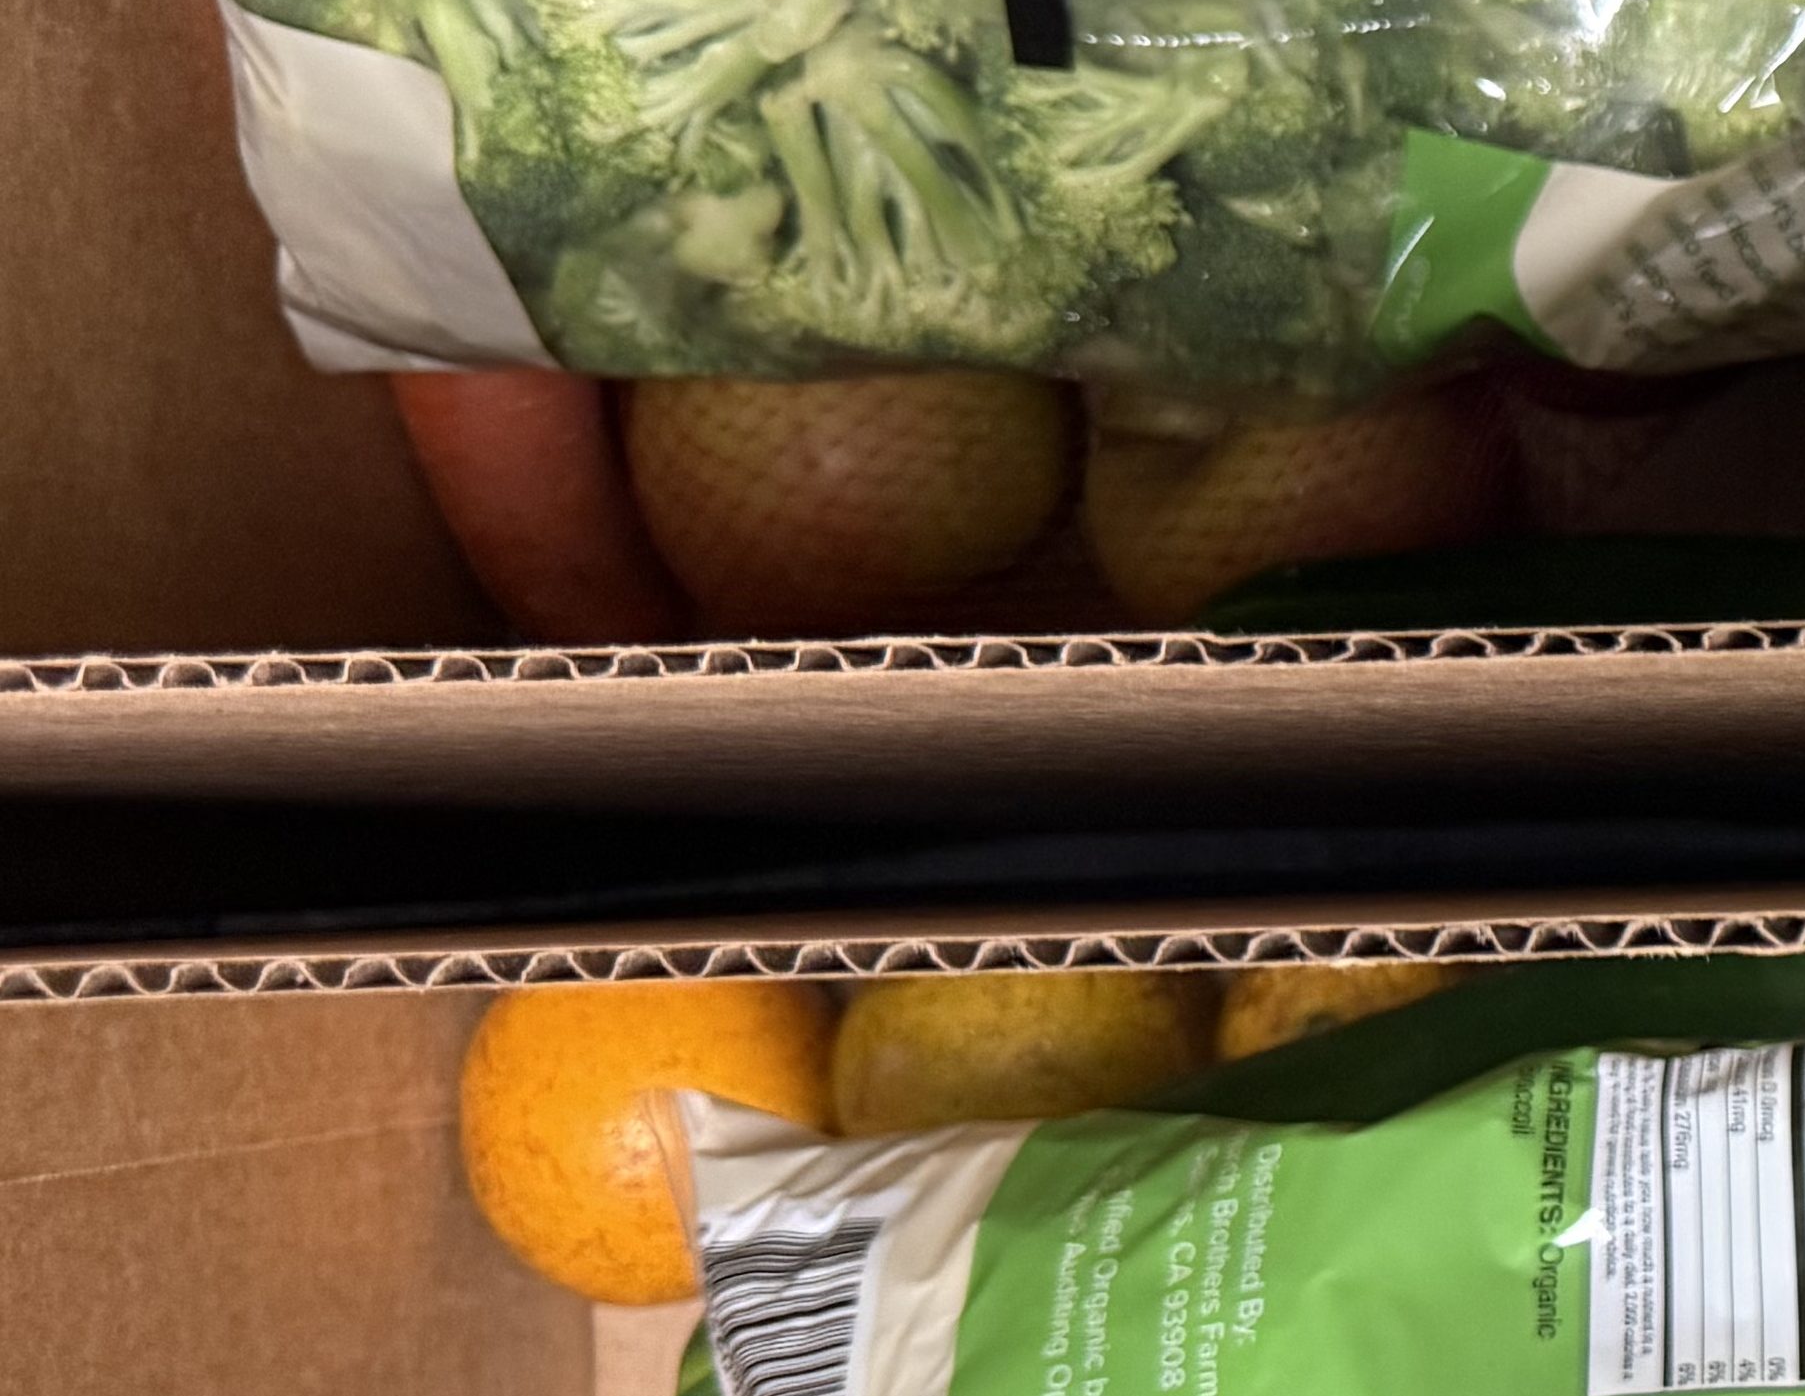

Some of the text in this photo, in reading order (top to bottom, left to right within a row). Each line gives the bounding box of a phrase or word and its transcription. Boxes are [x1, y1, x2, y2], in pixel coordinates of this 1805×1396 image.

[1673, 1112, 1691, 1171] 276mg
[1166, 1242, 1196, 1285] CA
[1200, 1199, 1239, 1315] Brothers
[1240, 1144, 1282, 1292] Distributed
[1042, 1243, 1087, 1355] Auditing
[1085, 1259, 1119, 1370] Organic
[1159, 1290, 1189, 1392] 93908
[1534, 1244, 1564, 1339] Organic
